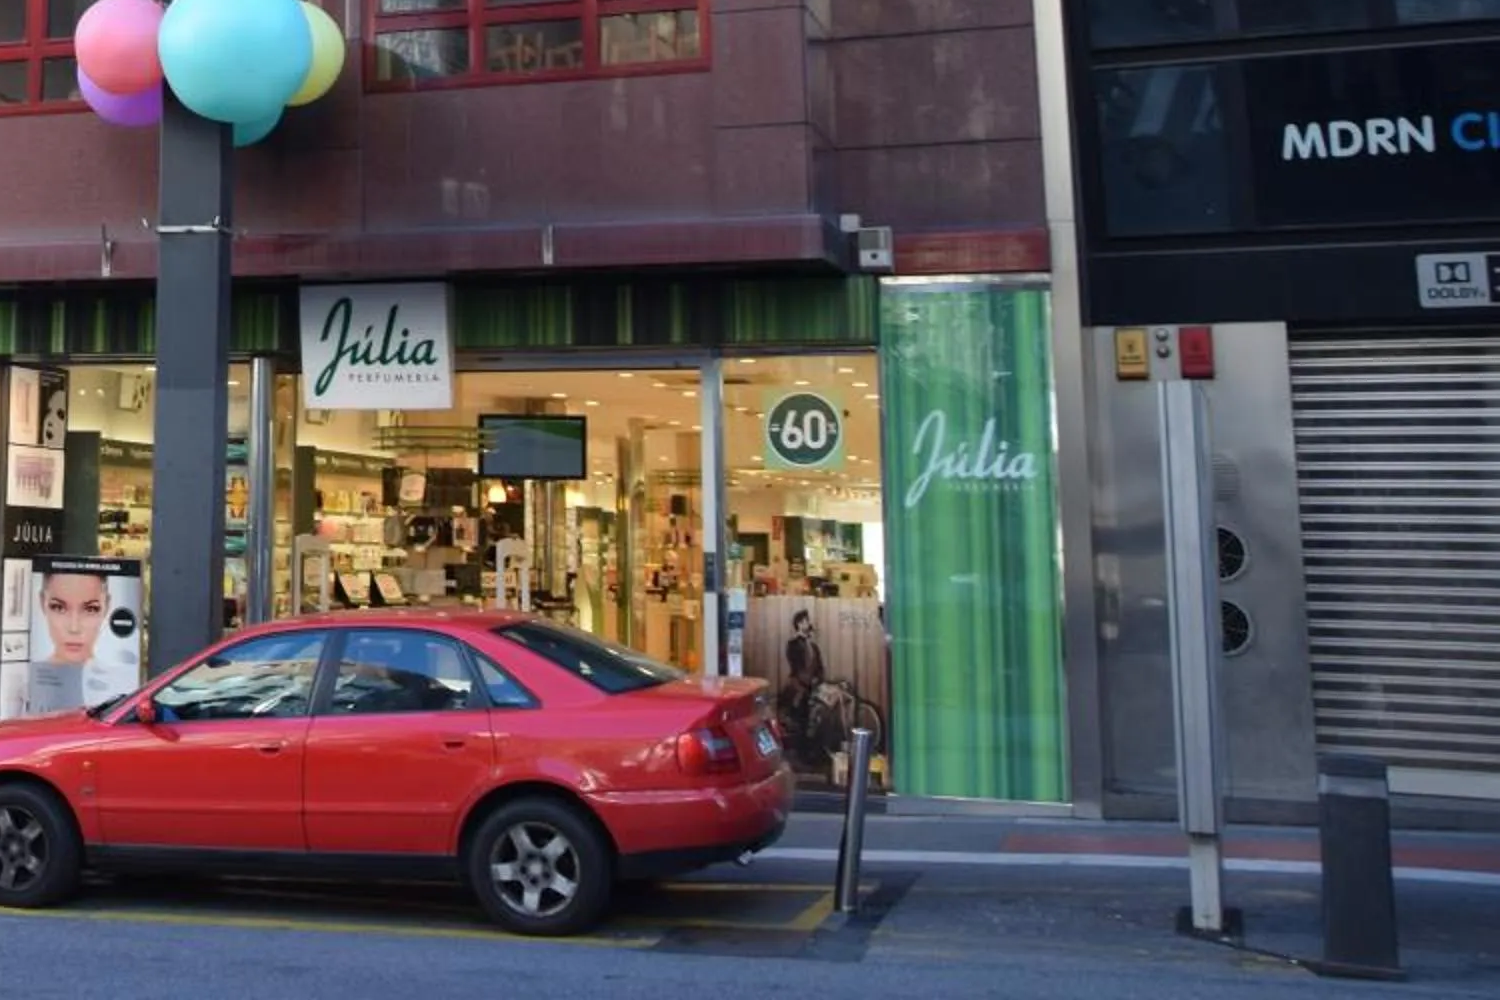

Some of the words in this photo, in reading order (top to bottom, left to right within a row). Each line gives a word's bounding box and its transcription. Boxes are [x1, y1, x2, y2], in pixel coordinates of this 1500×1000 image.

[1282, 115, 1436, 161] MDRN
[315, 297, 438, 396] Júlia
[904, 409, 1039, 508] Júlia
